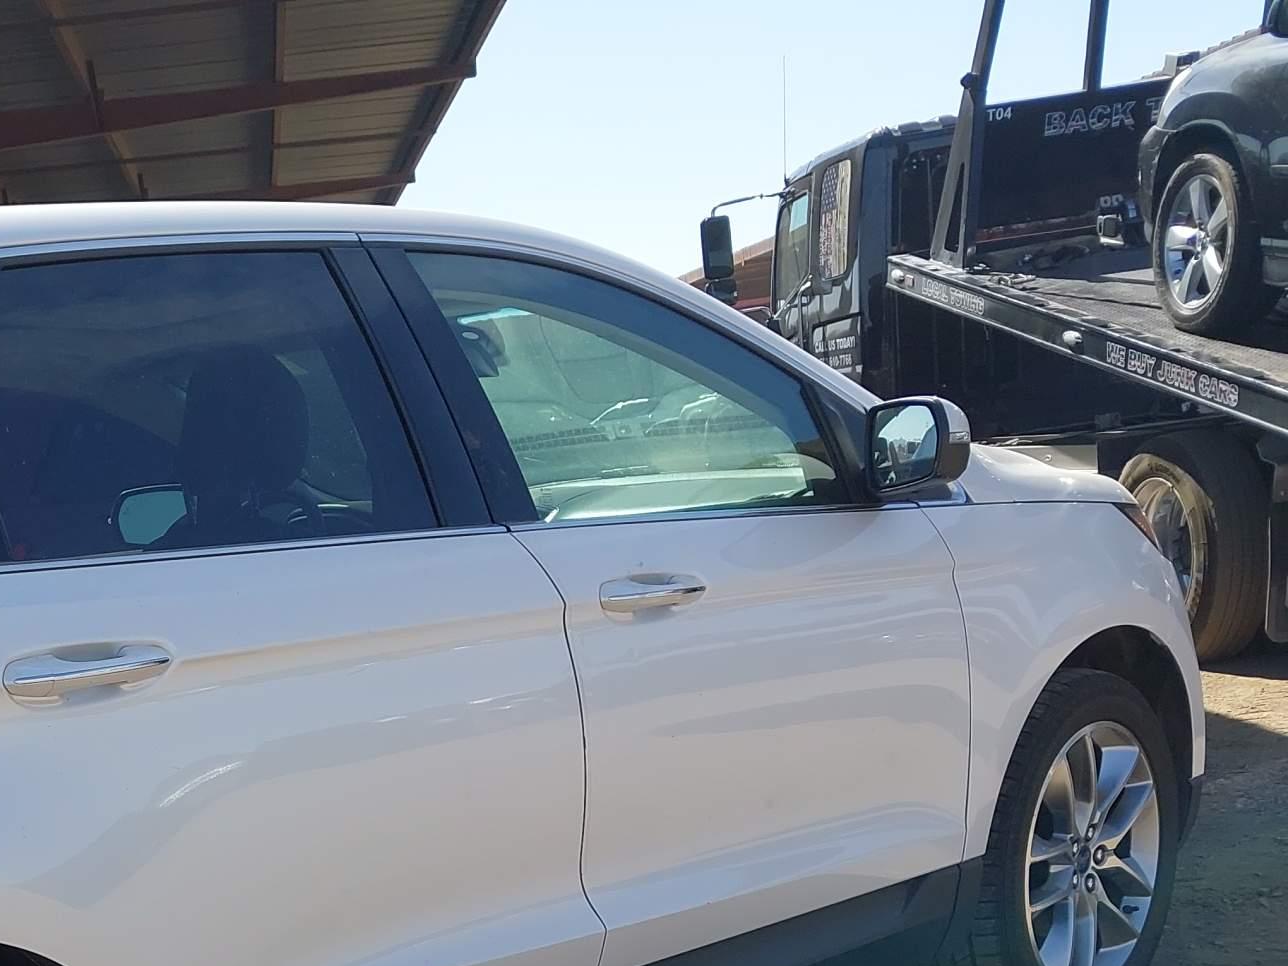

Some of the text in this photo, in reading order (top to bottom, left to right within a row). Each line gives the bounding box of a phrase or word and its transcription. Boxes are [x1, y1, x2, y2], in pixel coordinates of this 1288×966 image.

[987, 107, 1012, 121] T04
[1044, 101, 1136, 136] BACK
[922, 277, 985, 316] LOCAL TOWING
[828, 339, 836, 352] US
[836, 335, 856, 350] TODAY!
[1106, 341, 1239, 408] WE BUY JUNK CARS
